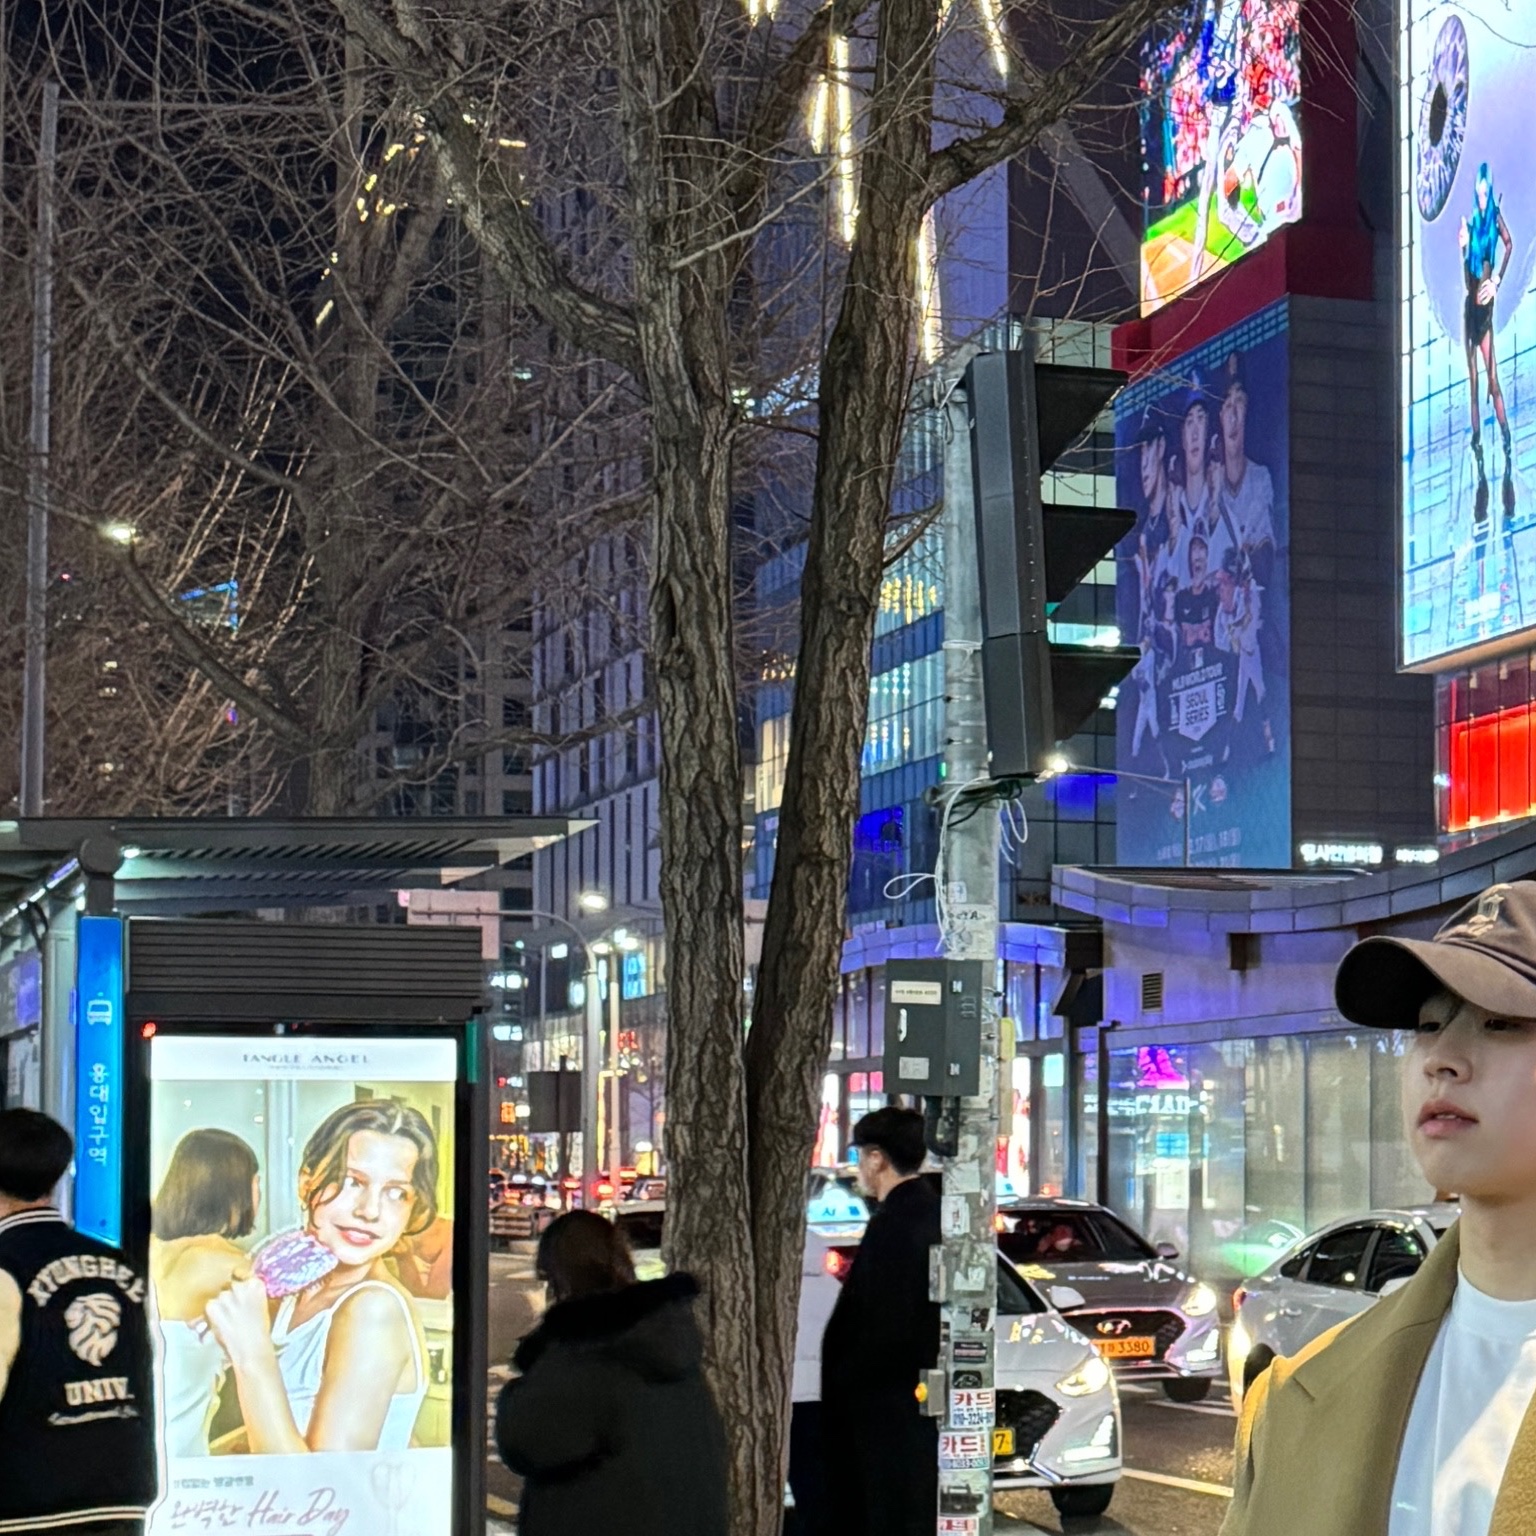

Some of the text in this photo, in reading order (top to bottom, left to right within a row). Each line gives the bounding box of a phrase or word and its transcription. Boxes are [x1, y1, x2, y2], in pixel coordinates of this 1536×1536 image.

[310, 1053, 369, 1064] ANGEL
[87, 1063, 111, 1167] 홍대입구역
[64, 1376, 136, 1406] UNIV.
[942, 1436, 978, 1453] 카드
[248, 1490, 296, 1527] Hair
